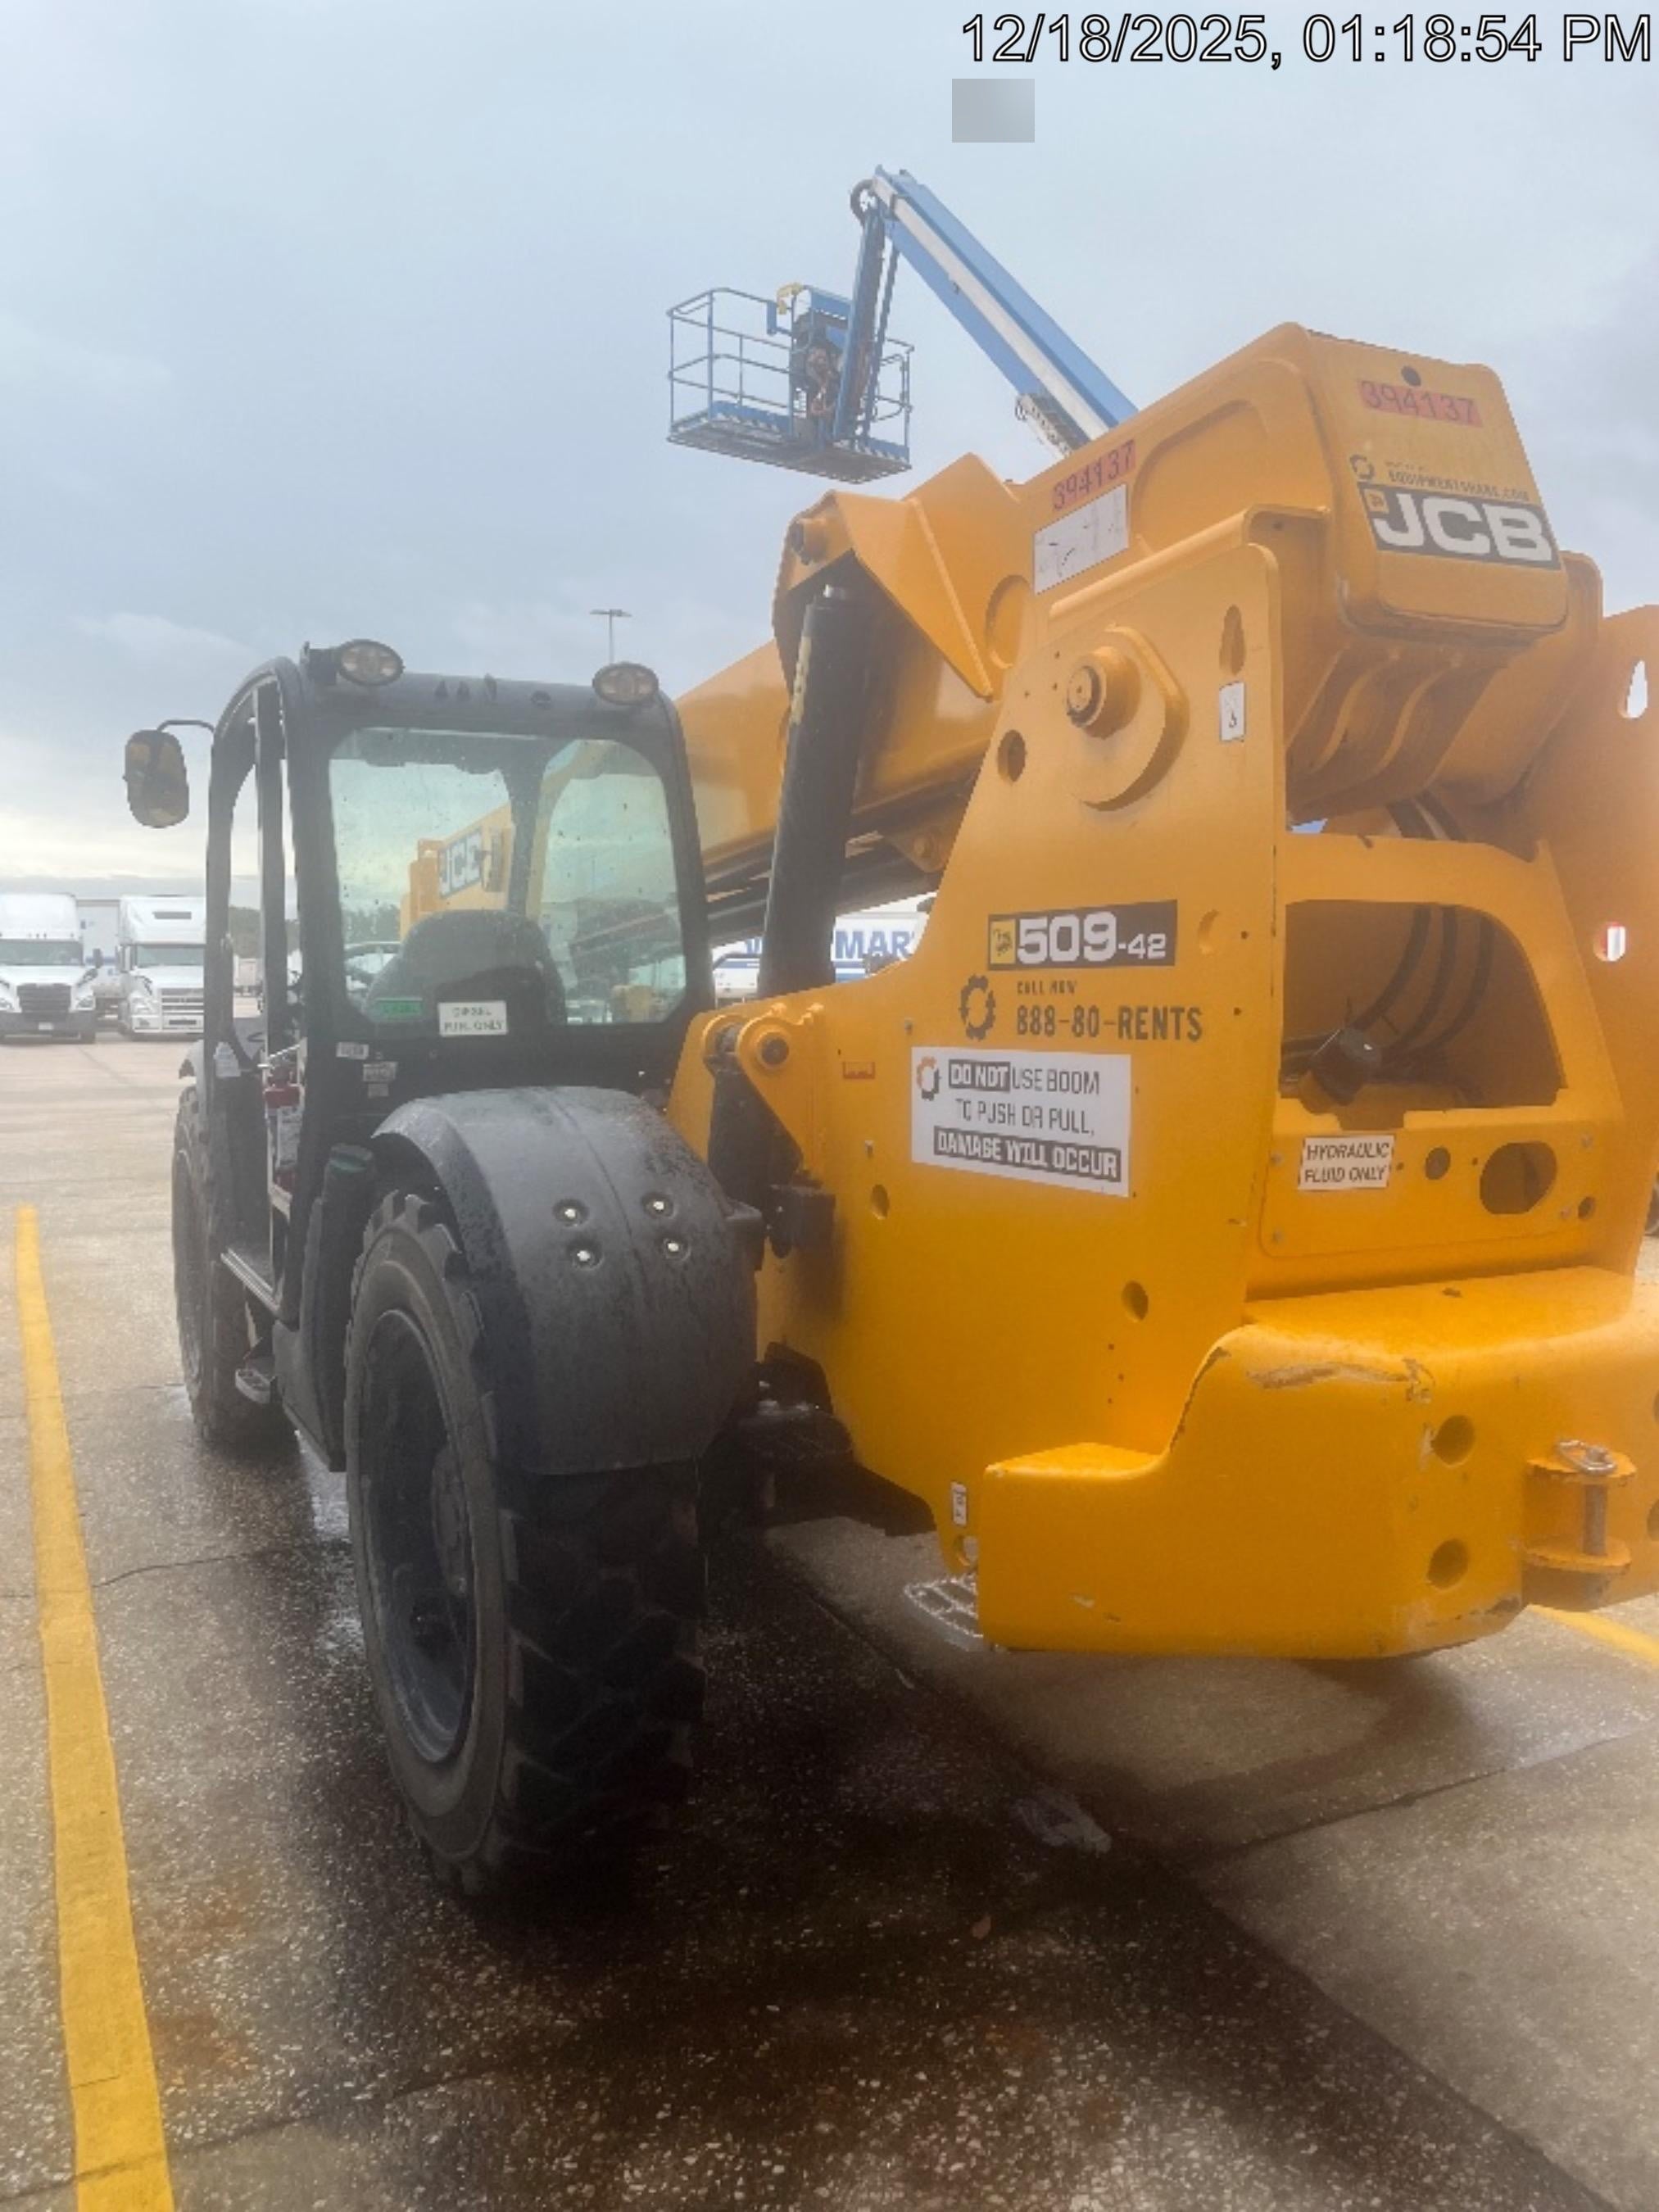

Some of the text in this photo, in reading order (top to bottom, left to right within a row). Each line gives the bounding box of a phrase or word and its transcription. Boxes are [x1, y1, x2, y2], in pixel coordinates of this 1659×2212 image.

[1359, 379, 1476, 426] 394137
[1052, 438, 1135, 511] 394137
[1372, 492, 1553, 562] JCB
[1017, 911, 1167, 965] 509-42
[1017, 1004, 1203, 1042] 888-80-RENTS
[950, 1063, 1100, 1095] DO NOT USE BOOM
[955, 1098, 972, 1122] TO
[977, 1100, 1017, 1127] PUSH
[1022, 1105, 1044, 1130] OR
[937, 1131, 1119, 1179] DAMAGE WILL OCCUR
[1306, 1142, 1390, 1161] HYDRAULIC
[1303, 1164, 1387, 1183] FLUID ONLY
